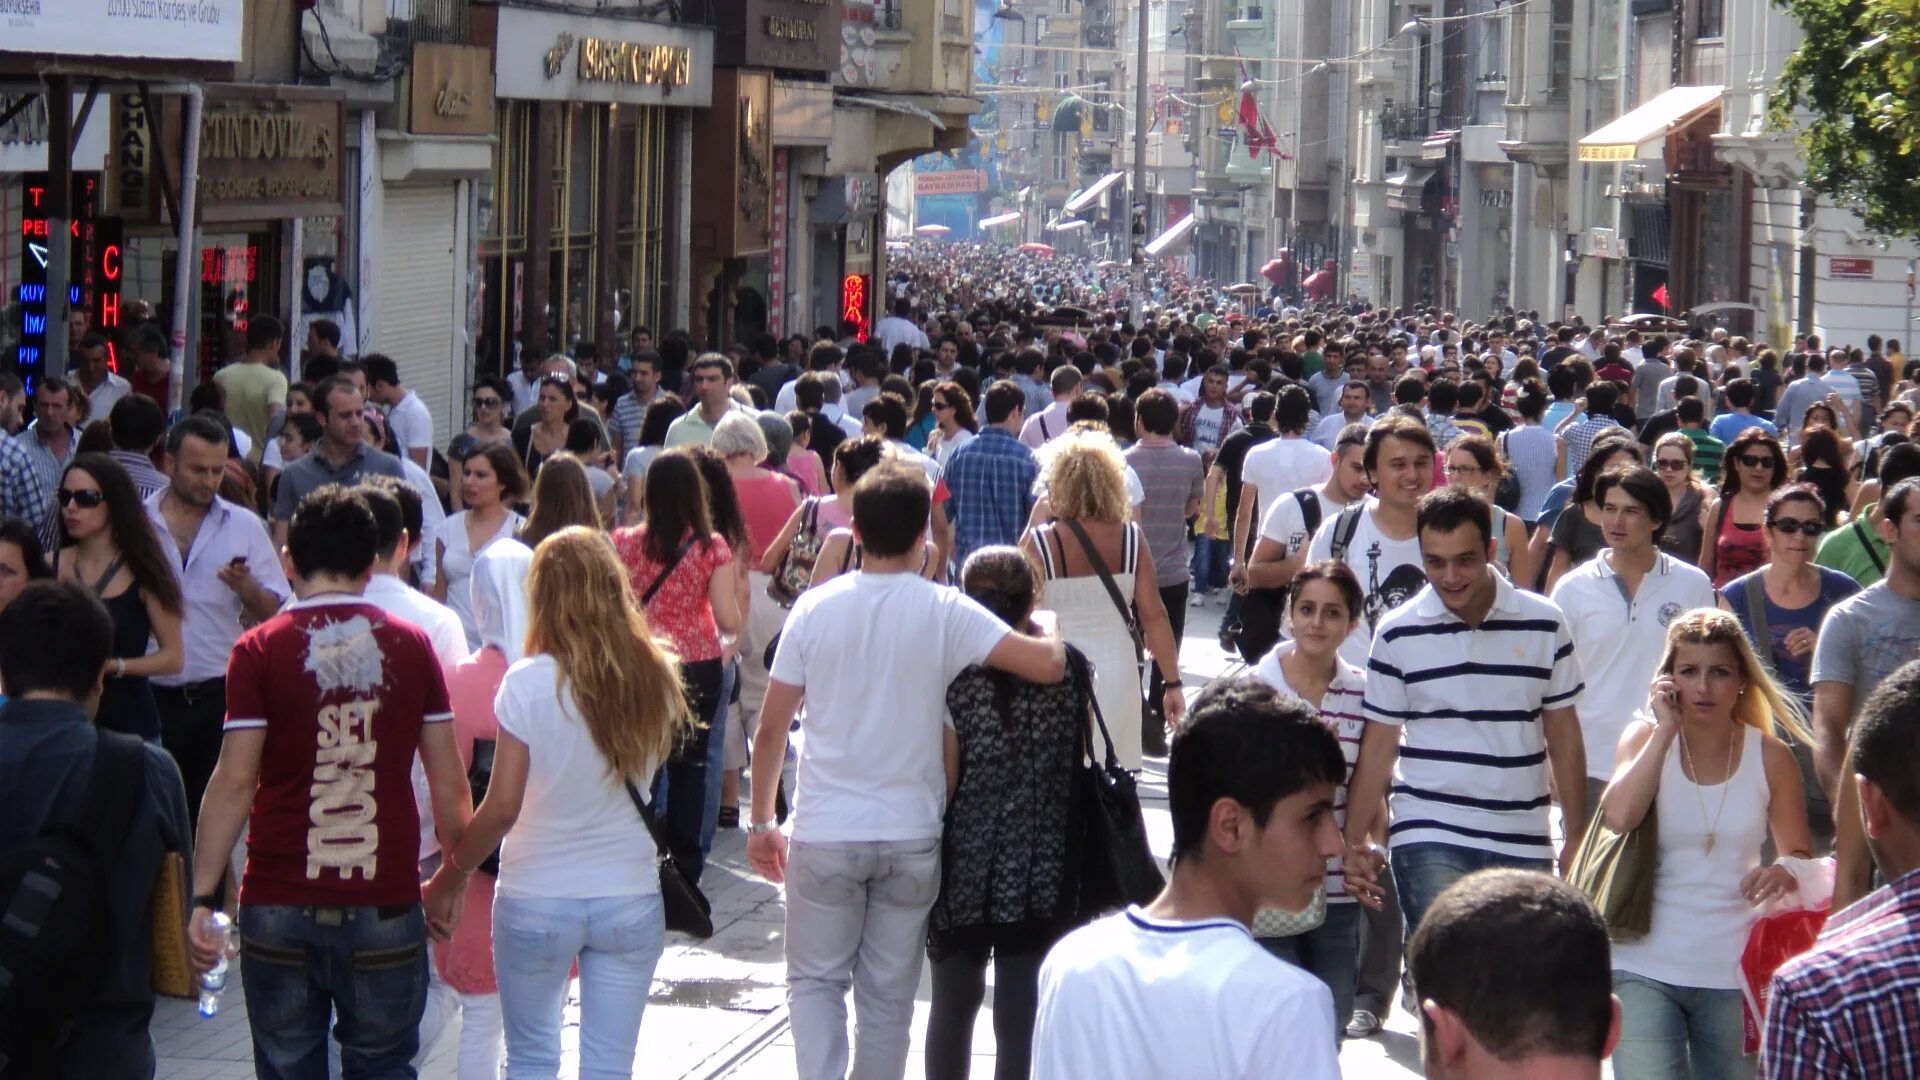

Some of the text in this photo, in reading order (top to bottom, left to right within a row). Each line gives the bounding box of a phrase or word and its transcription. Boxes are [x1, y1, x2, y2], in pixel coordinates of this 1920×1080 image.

[188, 4, 198, 22] ve
[118, 94, 144, 208] CHANGE
[317, 700, 380, 748] SET
